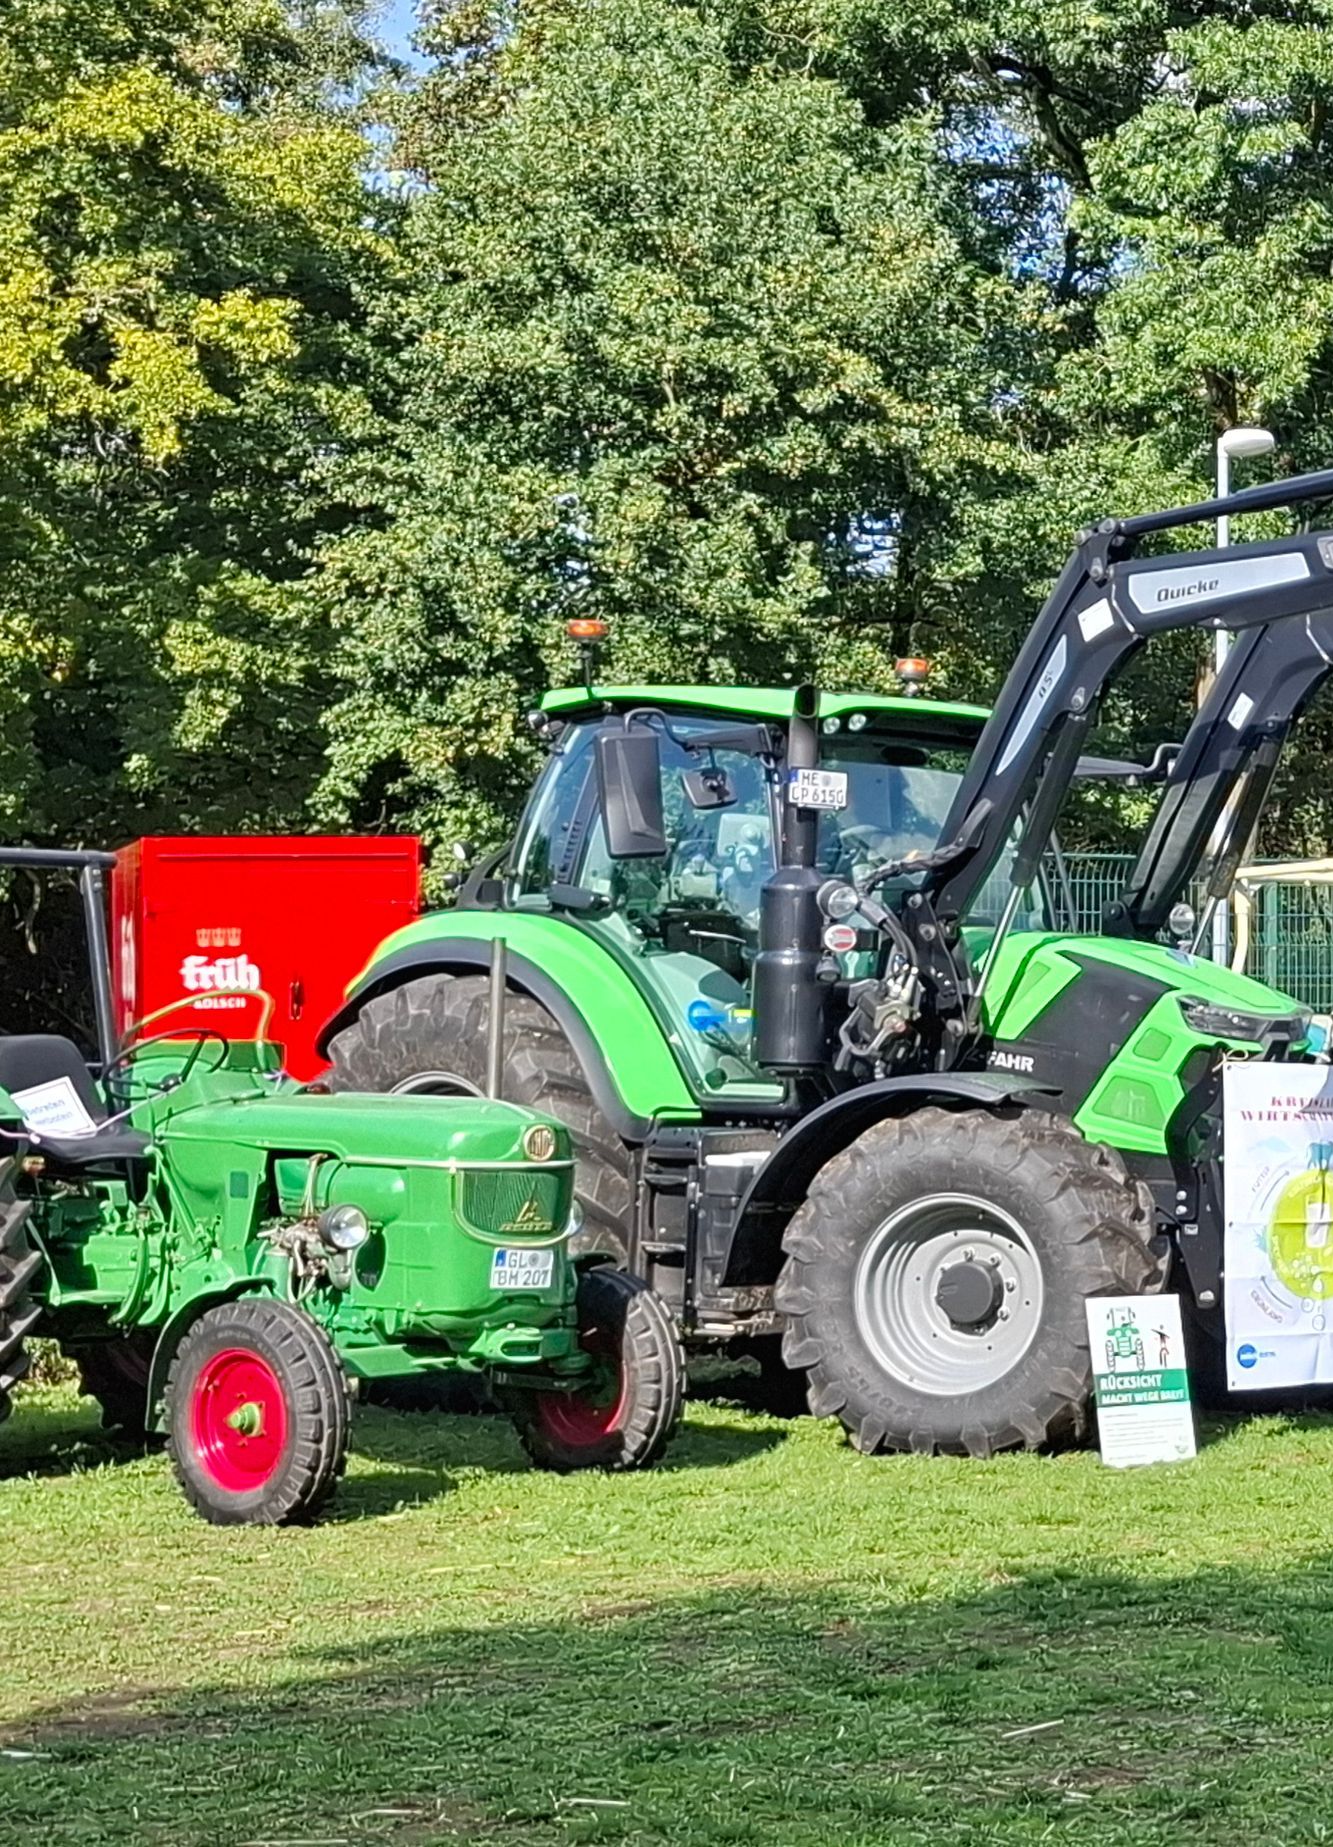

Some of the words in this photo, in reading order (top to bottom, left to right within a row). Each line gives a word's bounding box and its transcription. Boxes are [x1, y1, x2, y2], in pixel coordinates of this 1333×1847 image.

[1157, 579, 1219, 602] Quicke
[179, 953, 261, 991] früh
[508, 1252, 528, 1268] GL
[522, 1269, 549, 1286] 207
[1100, 1374, 1162, 1391] RÜCKSICHT
